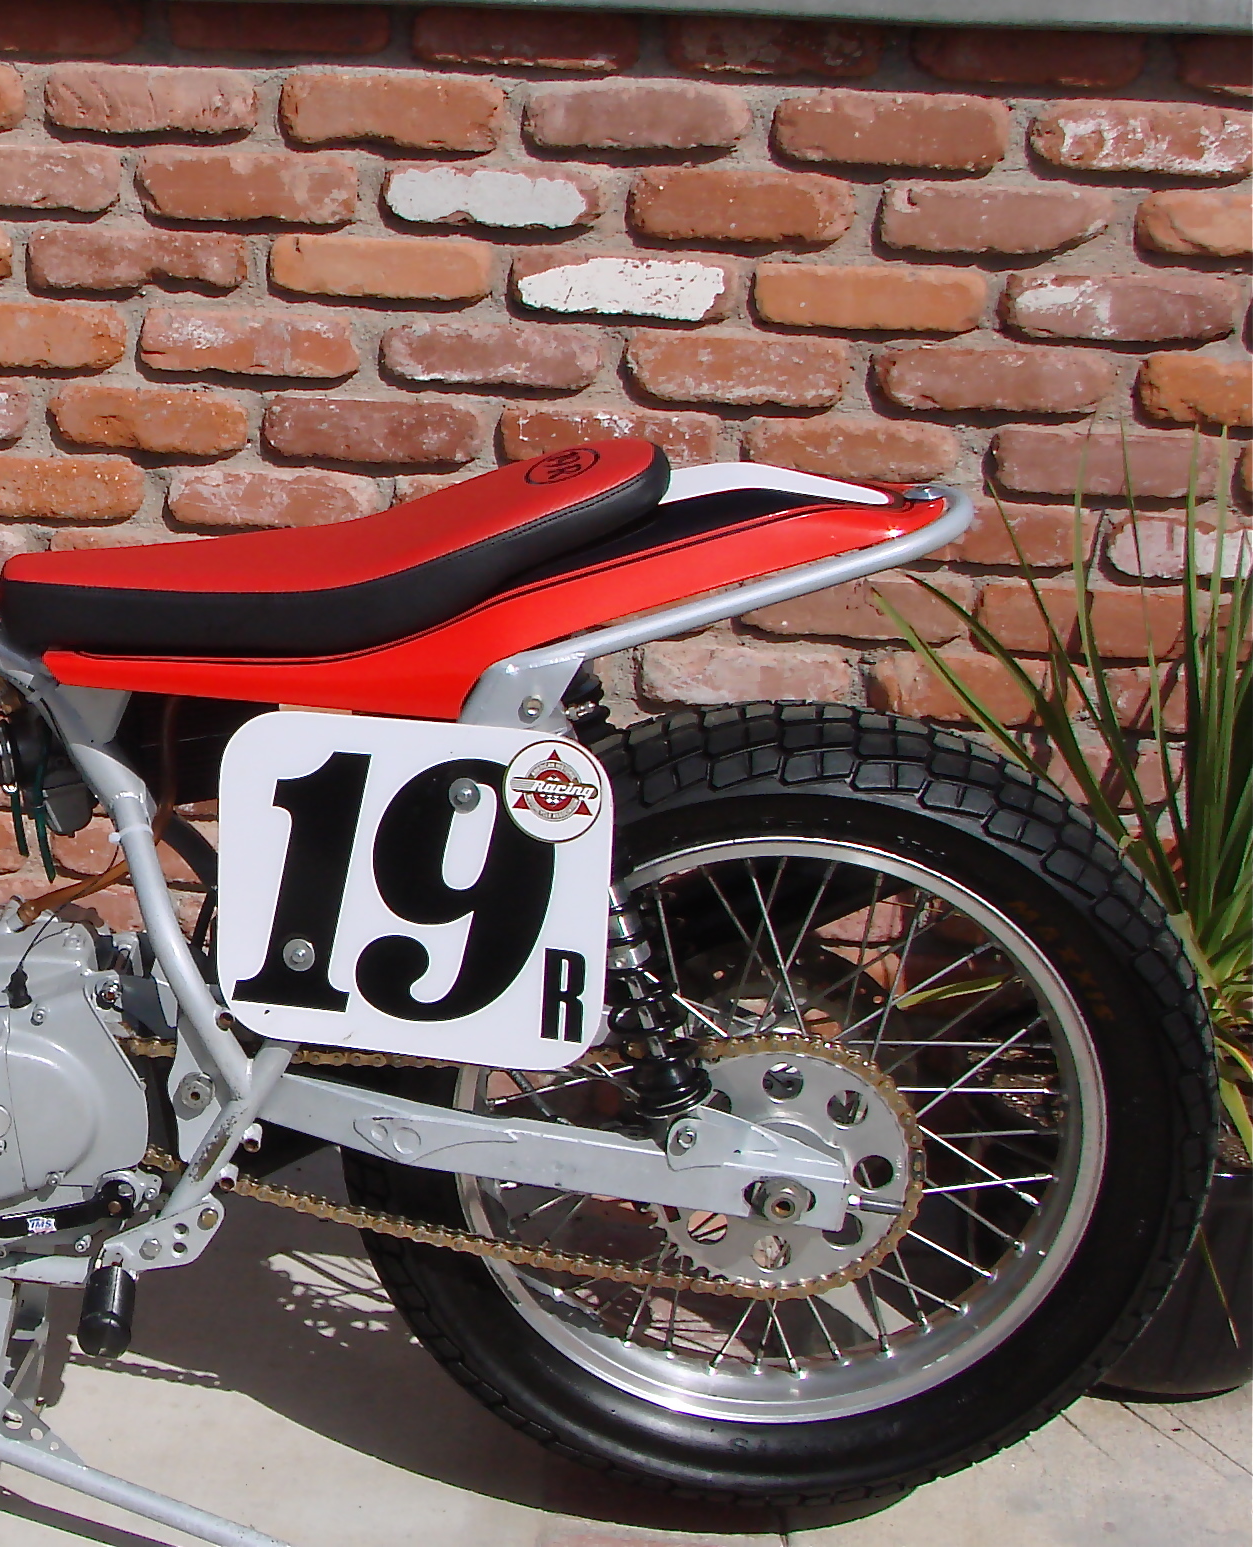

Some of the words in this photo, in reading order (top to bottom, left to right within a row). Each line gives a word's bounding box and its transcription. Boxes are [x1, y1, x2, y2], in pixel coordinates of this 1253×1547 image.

[531, 781, 596, 801] Racing
[231, 751, 554, 1022] 19
[541, 947, 588, 1043] R
